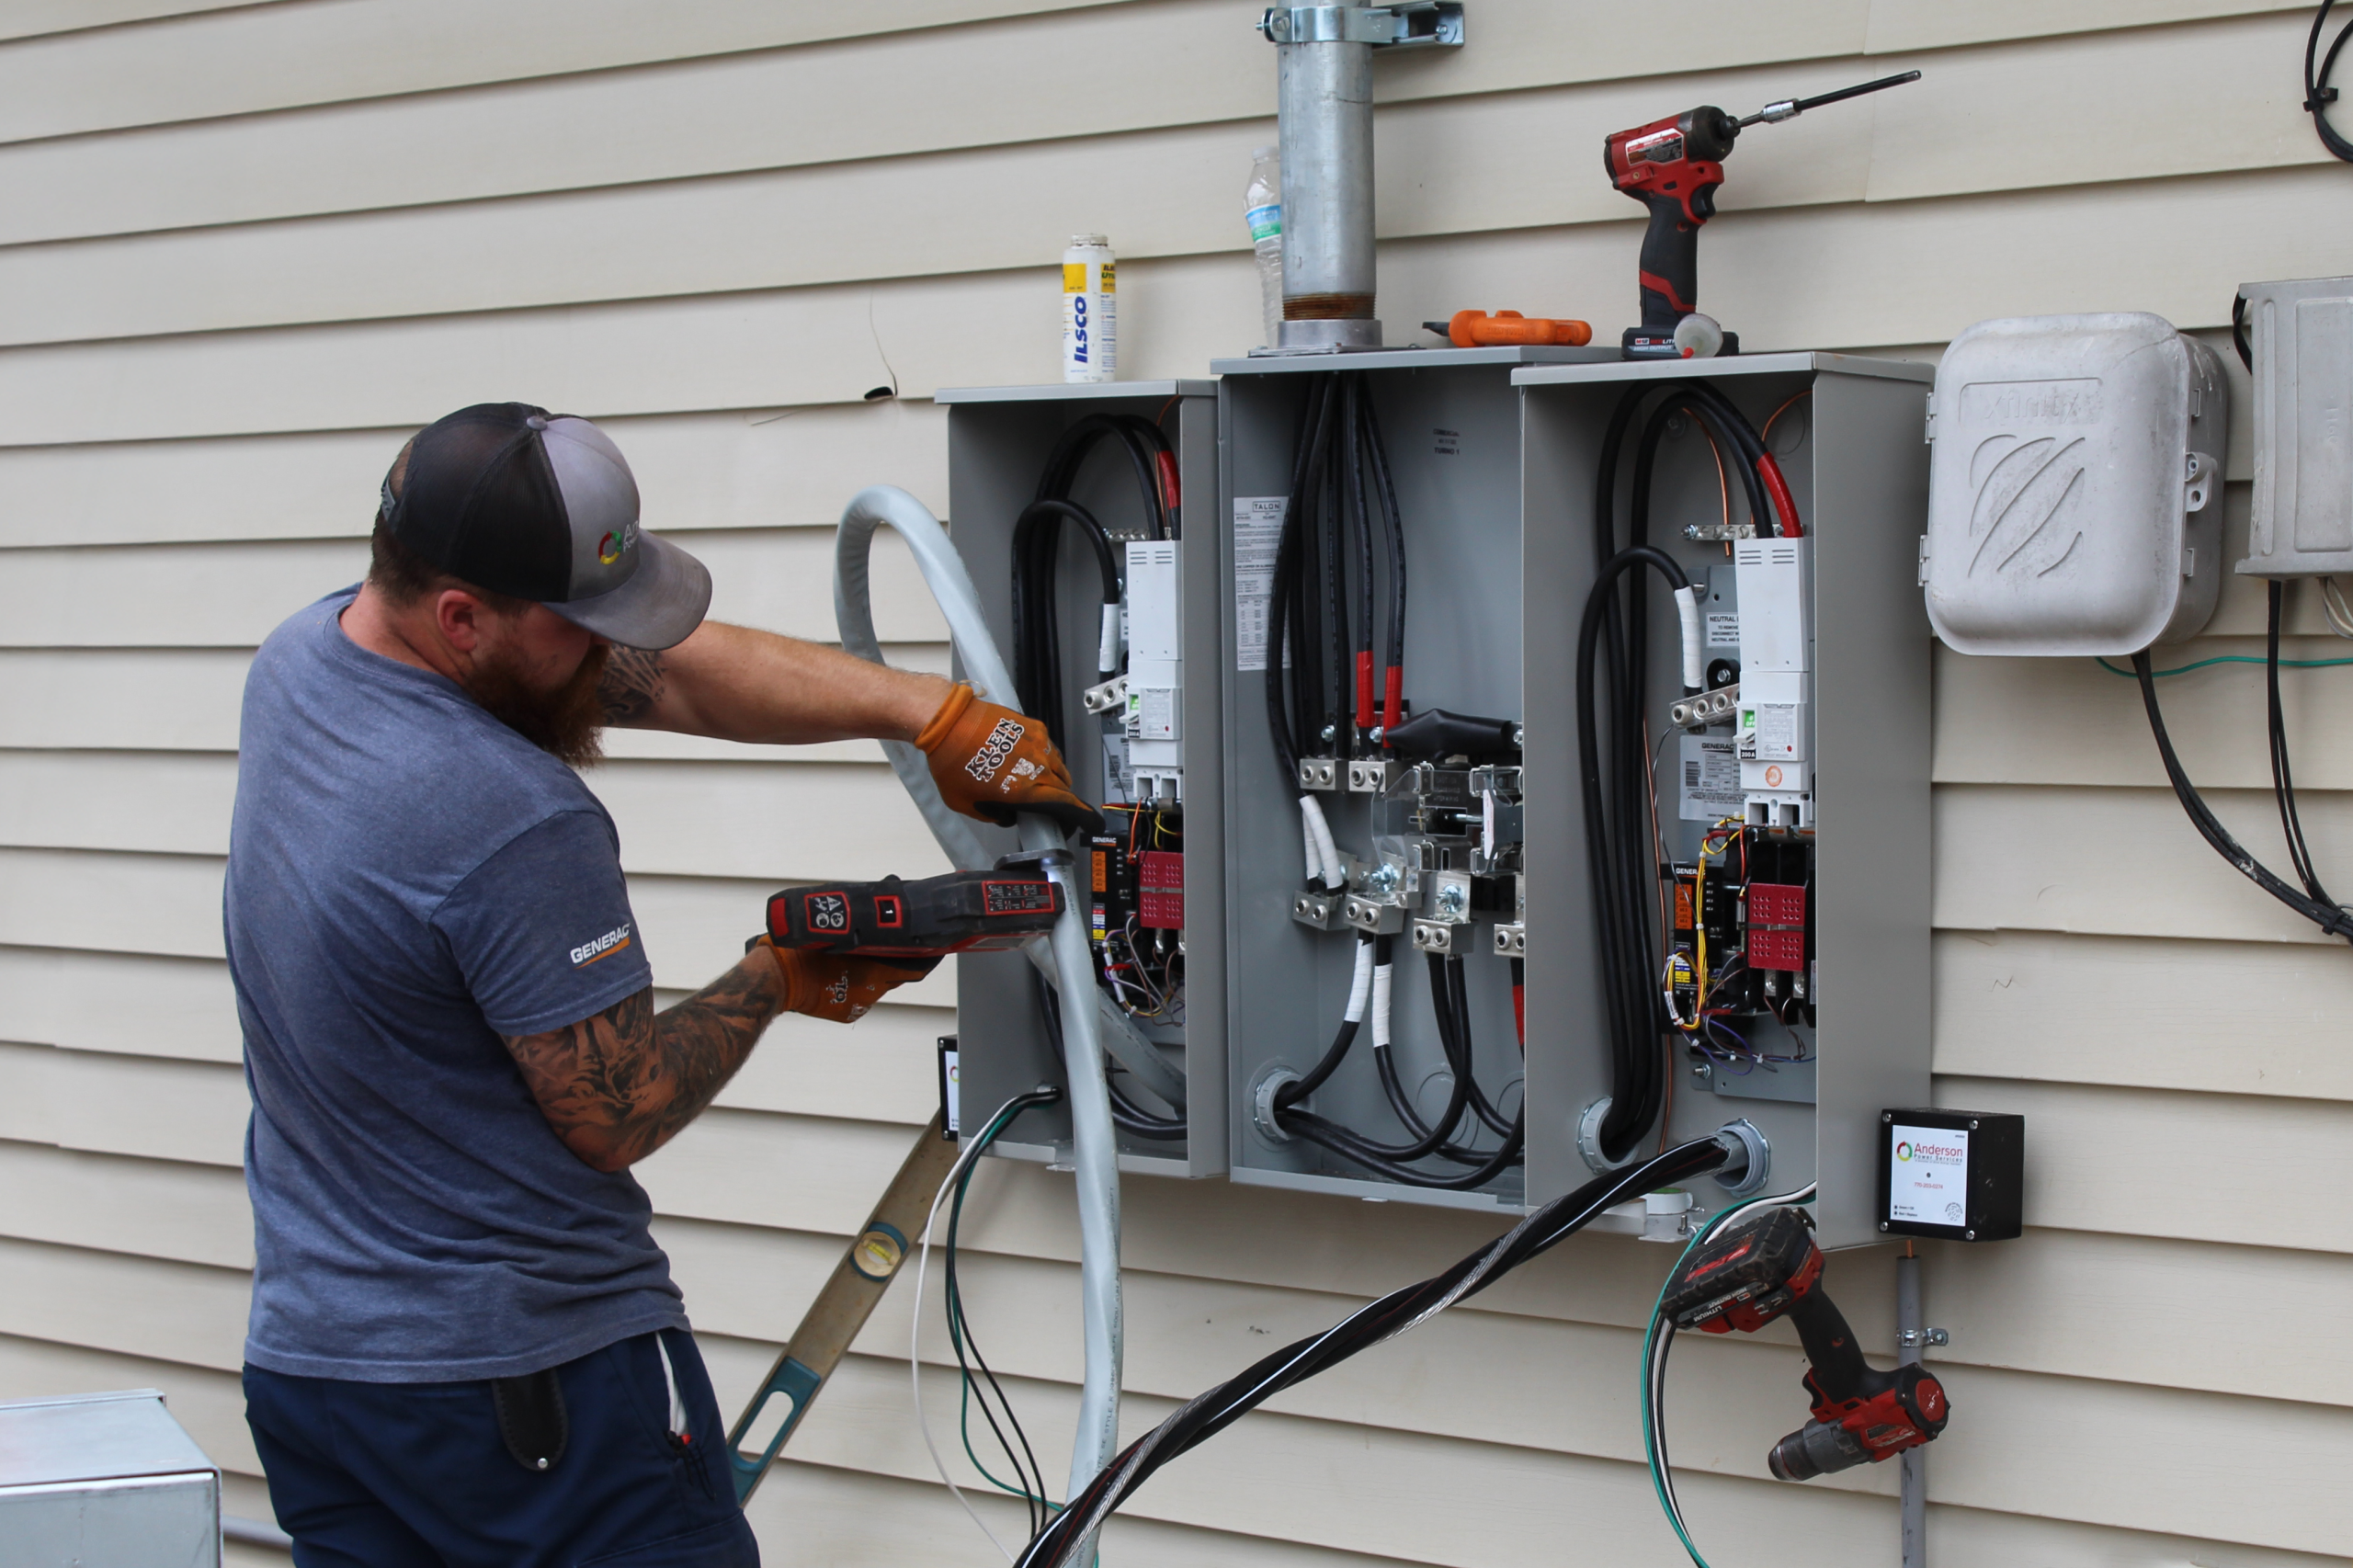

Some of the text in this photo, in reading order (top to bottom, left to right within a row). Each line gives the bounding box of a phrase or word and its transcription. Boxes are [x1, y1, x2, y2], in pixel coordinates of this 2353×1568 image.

[1074, 296, 1088, 363] ILSCO
[965, 718, 1012, 777] KLEIN
[976, 723, 1025, 782] TOOLS
[570, 923, 631, 964] GENERAC
[1915, 1142, 1963, 1157] Anderson
[1105, 1407, 1113, 1433] STYLE
